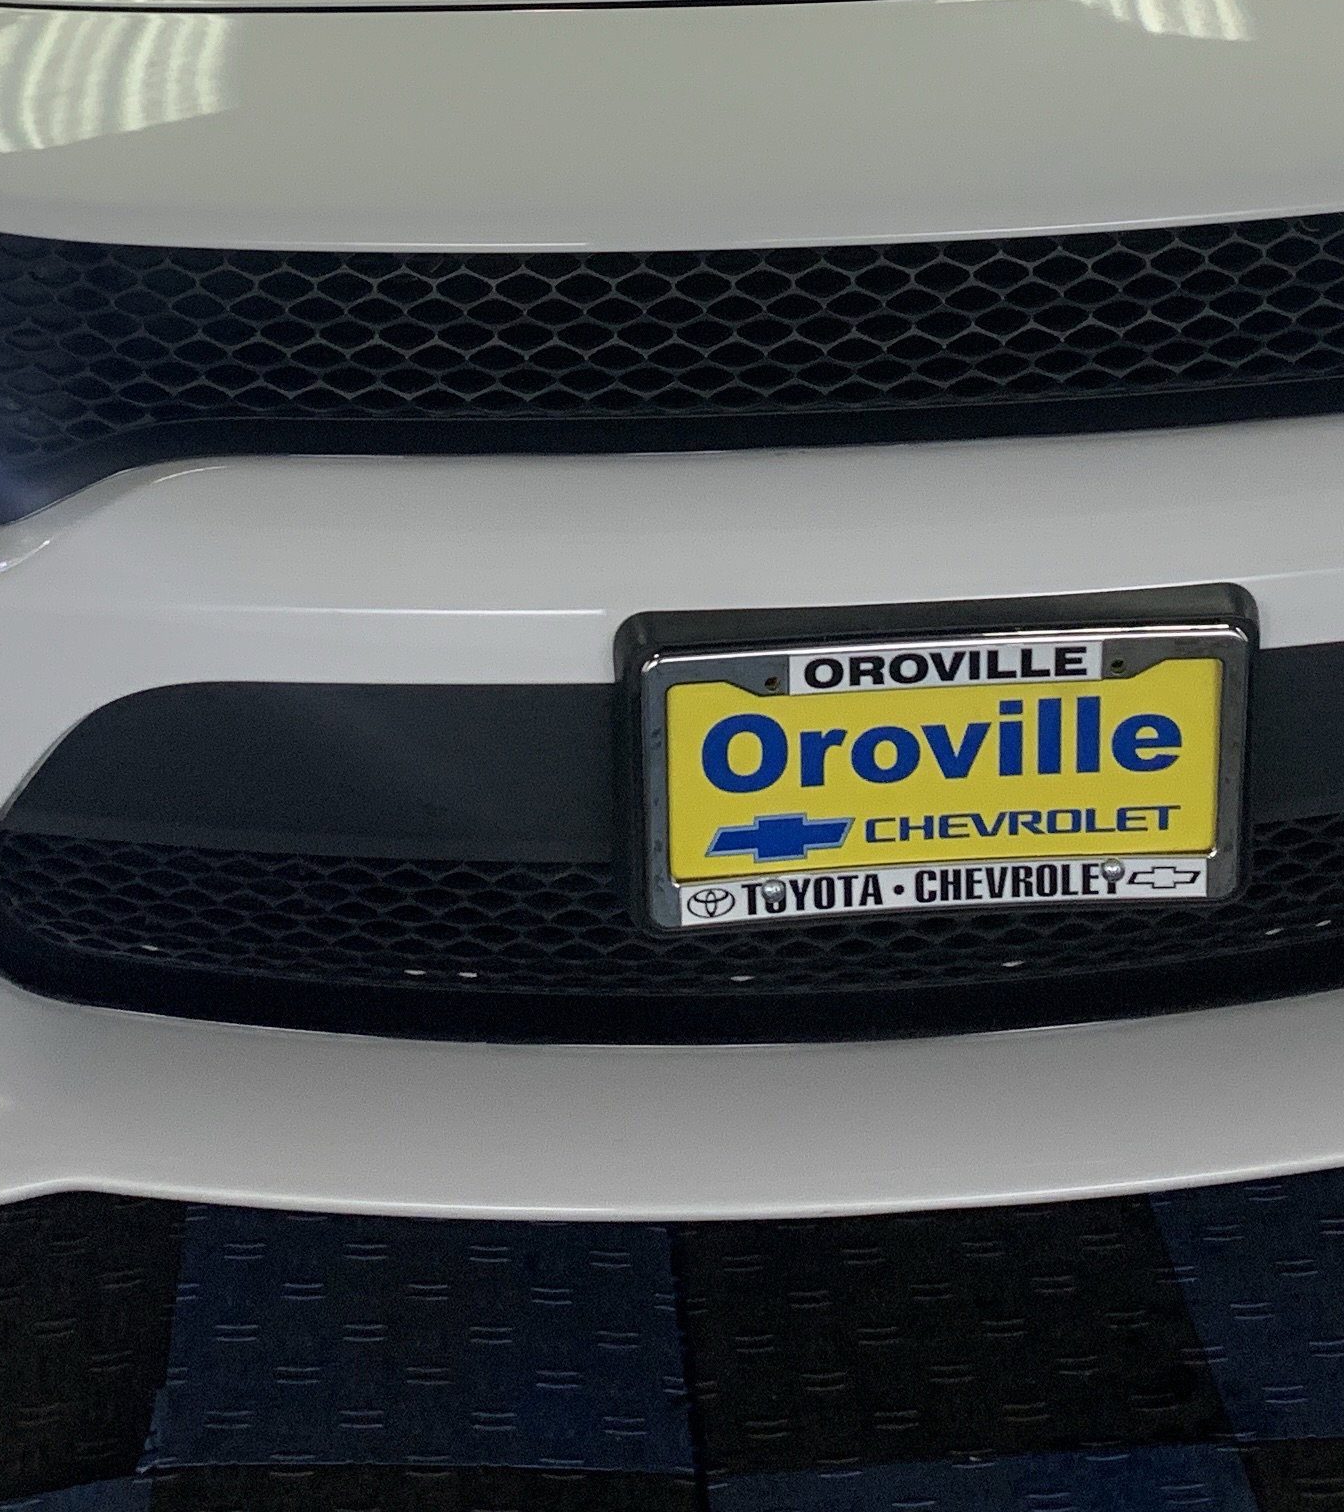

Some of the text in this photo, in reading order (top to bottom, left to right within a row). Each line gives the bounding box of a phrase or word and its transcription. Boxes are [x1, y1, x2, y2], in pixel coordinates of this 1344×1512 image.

[803, 645, 1089, 689] OROVILLE
[700, 695, 1184, 794] Oroville
[864, 805, 1182, 844] CHEVROLET
